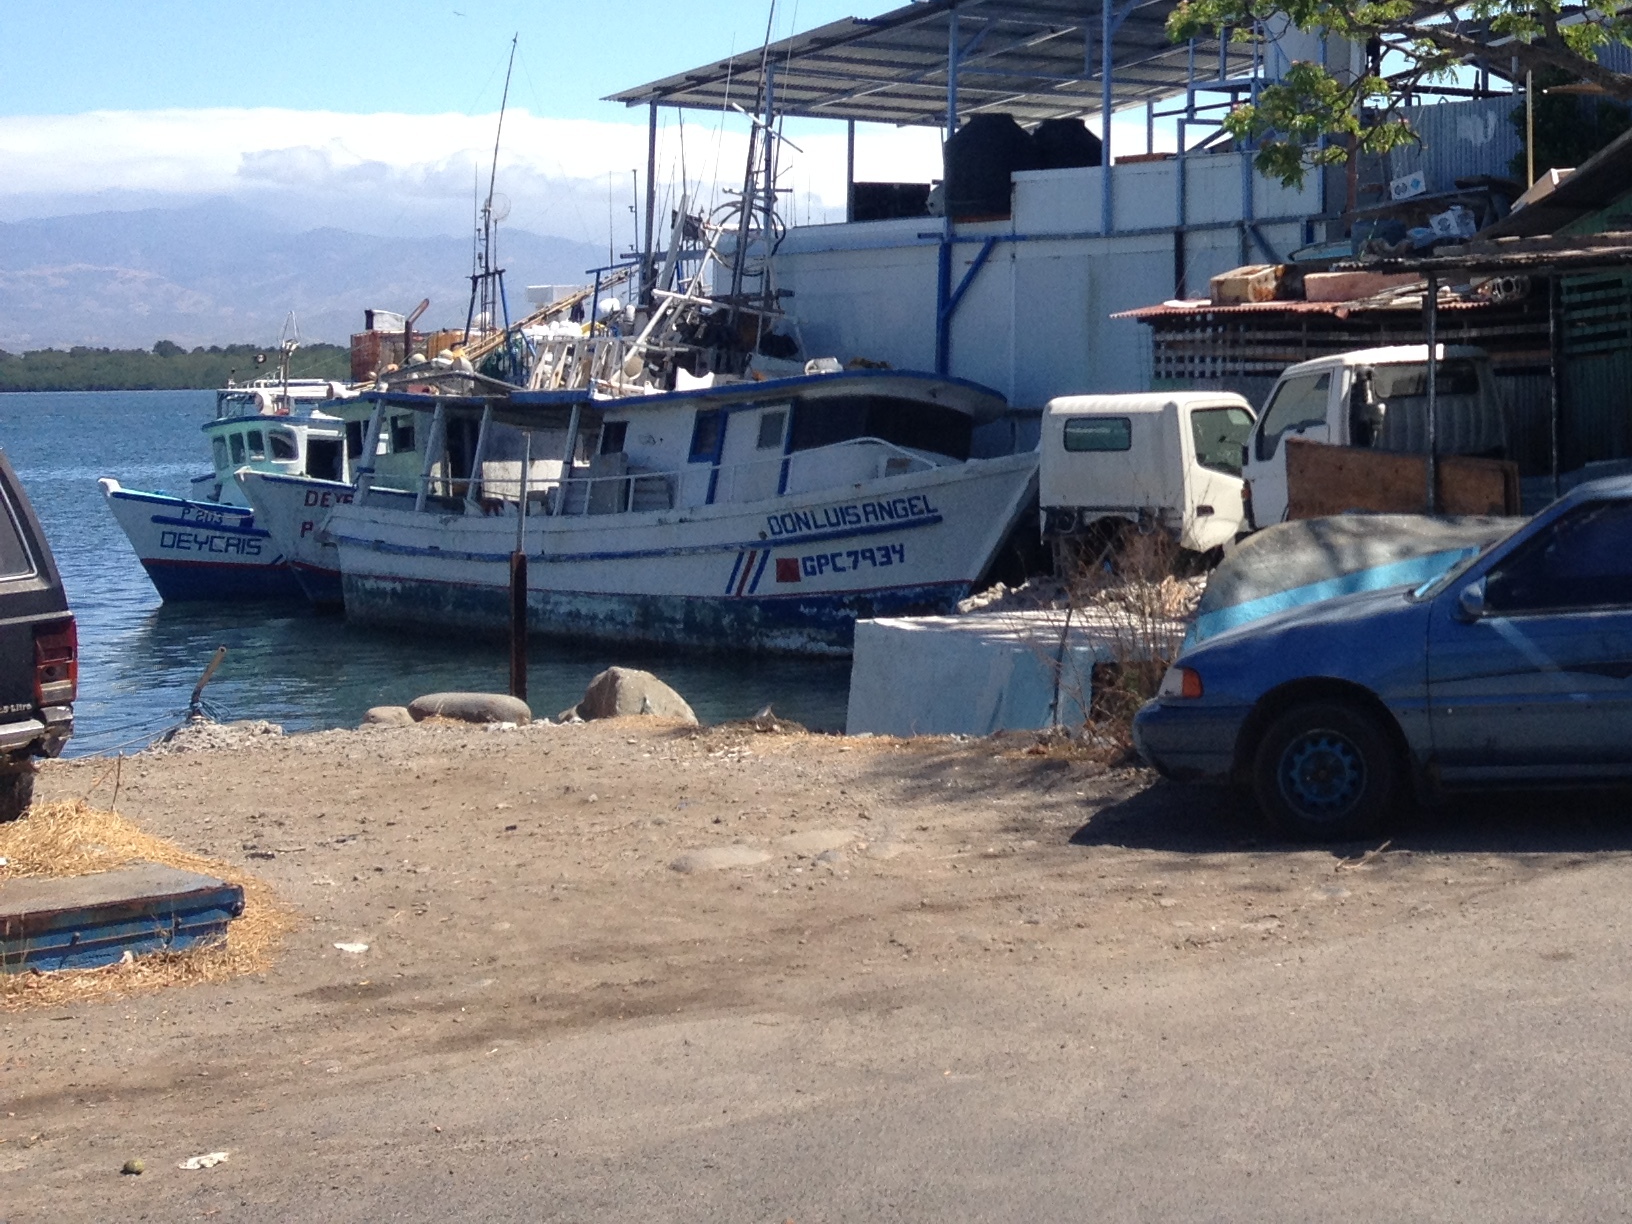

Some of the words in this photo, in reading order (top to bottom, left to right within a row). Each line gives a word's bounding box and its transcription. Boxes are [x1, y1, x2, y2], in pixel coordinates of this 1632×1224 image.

[766, 511, 811, 536] DON
[811, 505, 861, 529] LUIS
[862, 494, 939, 523] ANGEL
